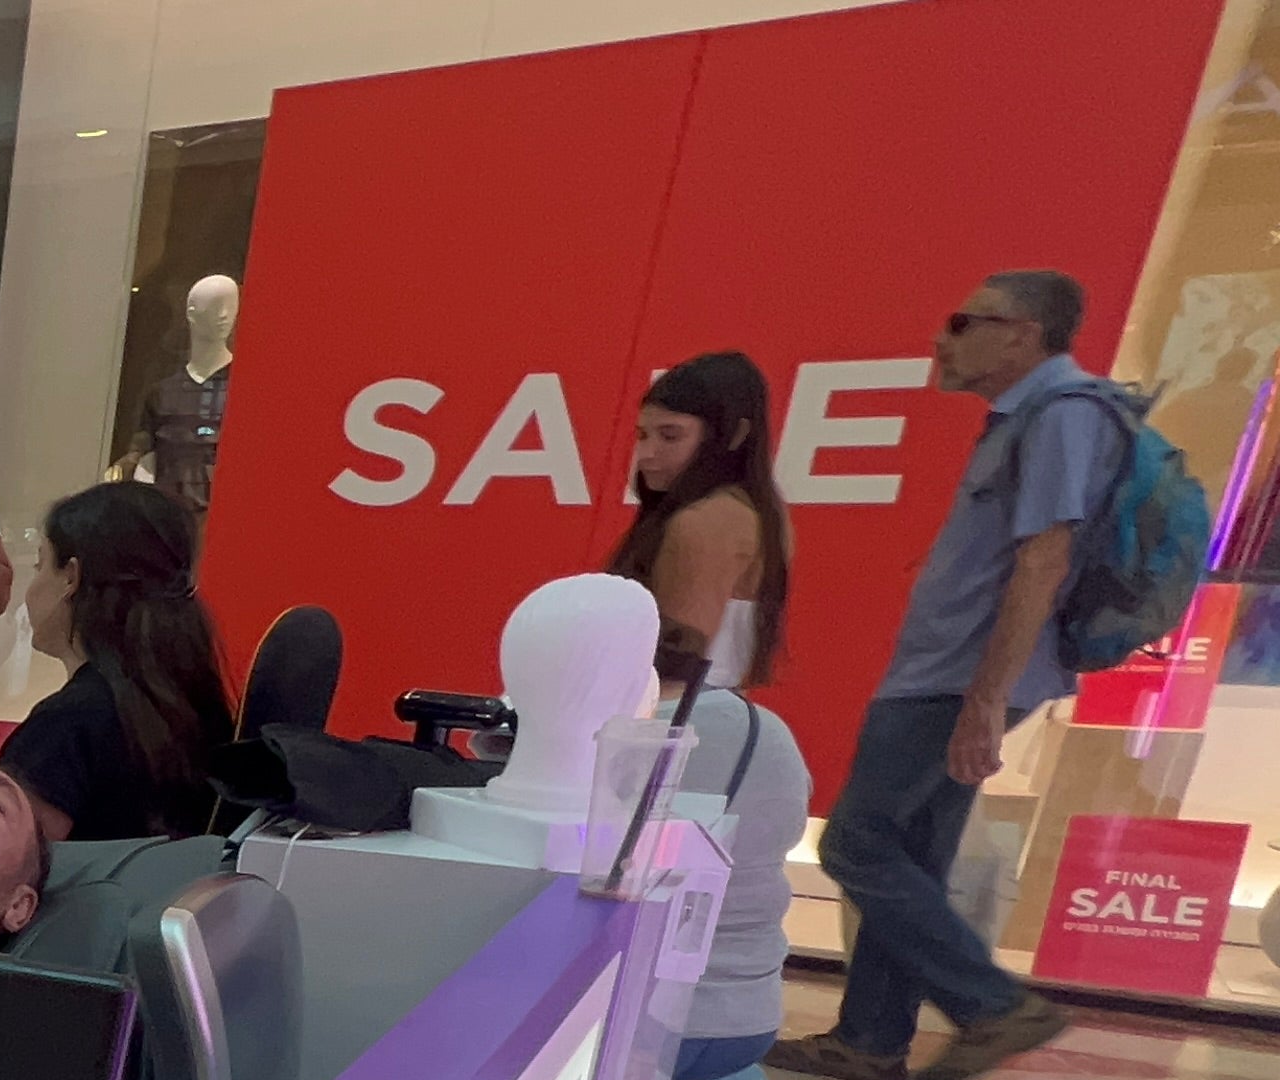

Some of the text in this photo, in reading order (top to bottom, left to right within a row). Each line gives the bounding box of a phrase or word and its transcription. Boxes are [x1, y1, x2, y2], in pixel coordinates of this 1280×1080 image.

[327, 357, 934, 506] SAE
[1105, 870, 1181, 890] FINAL
[1066, 887, 1210, 927] SALE
